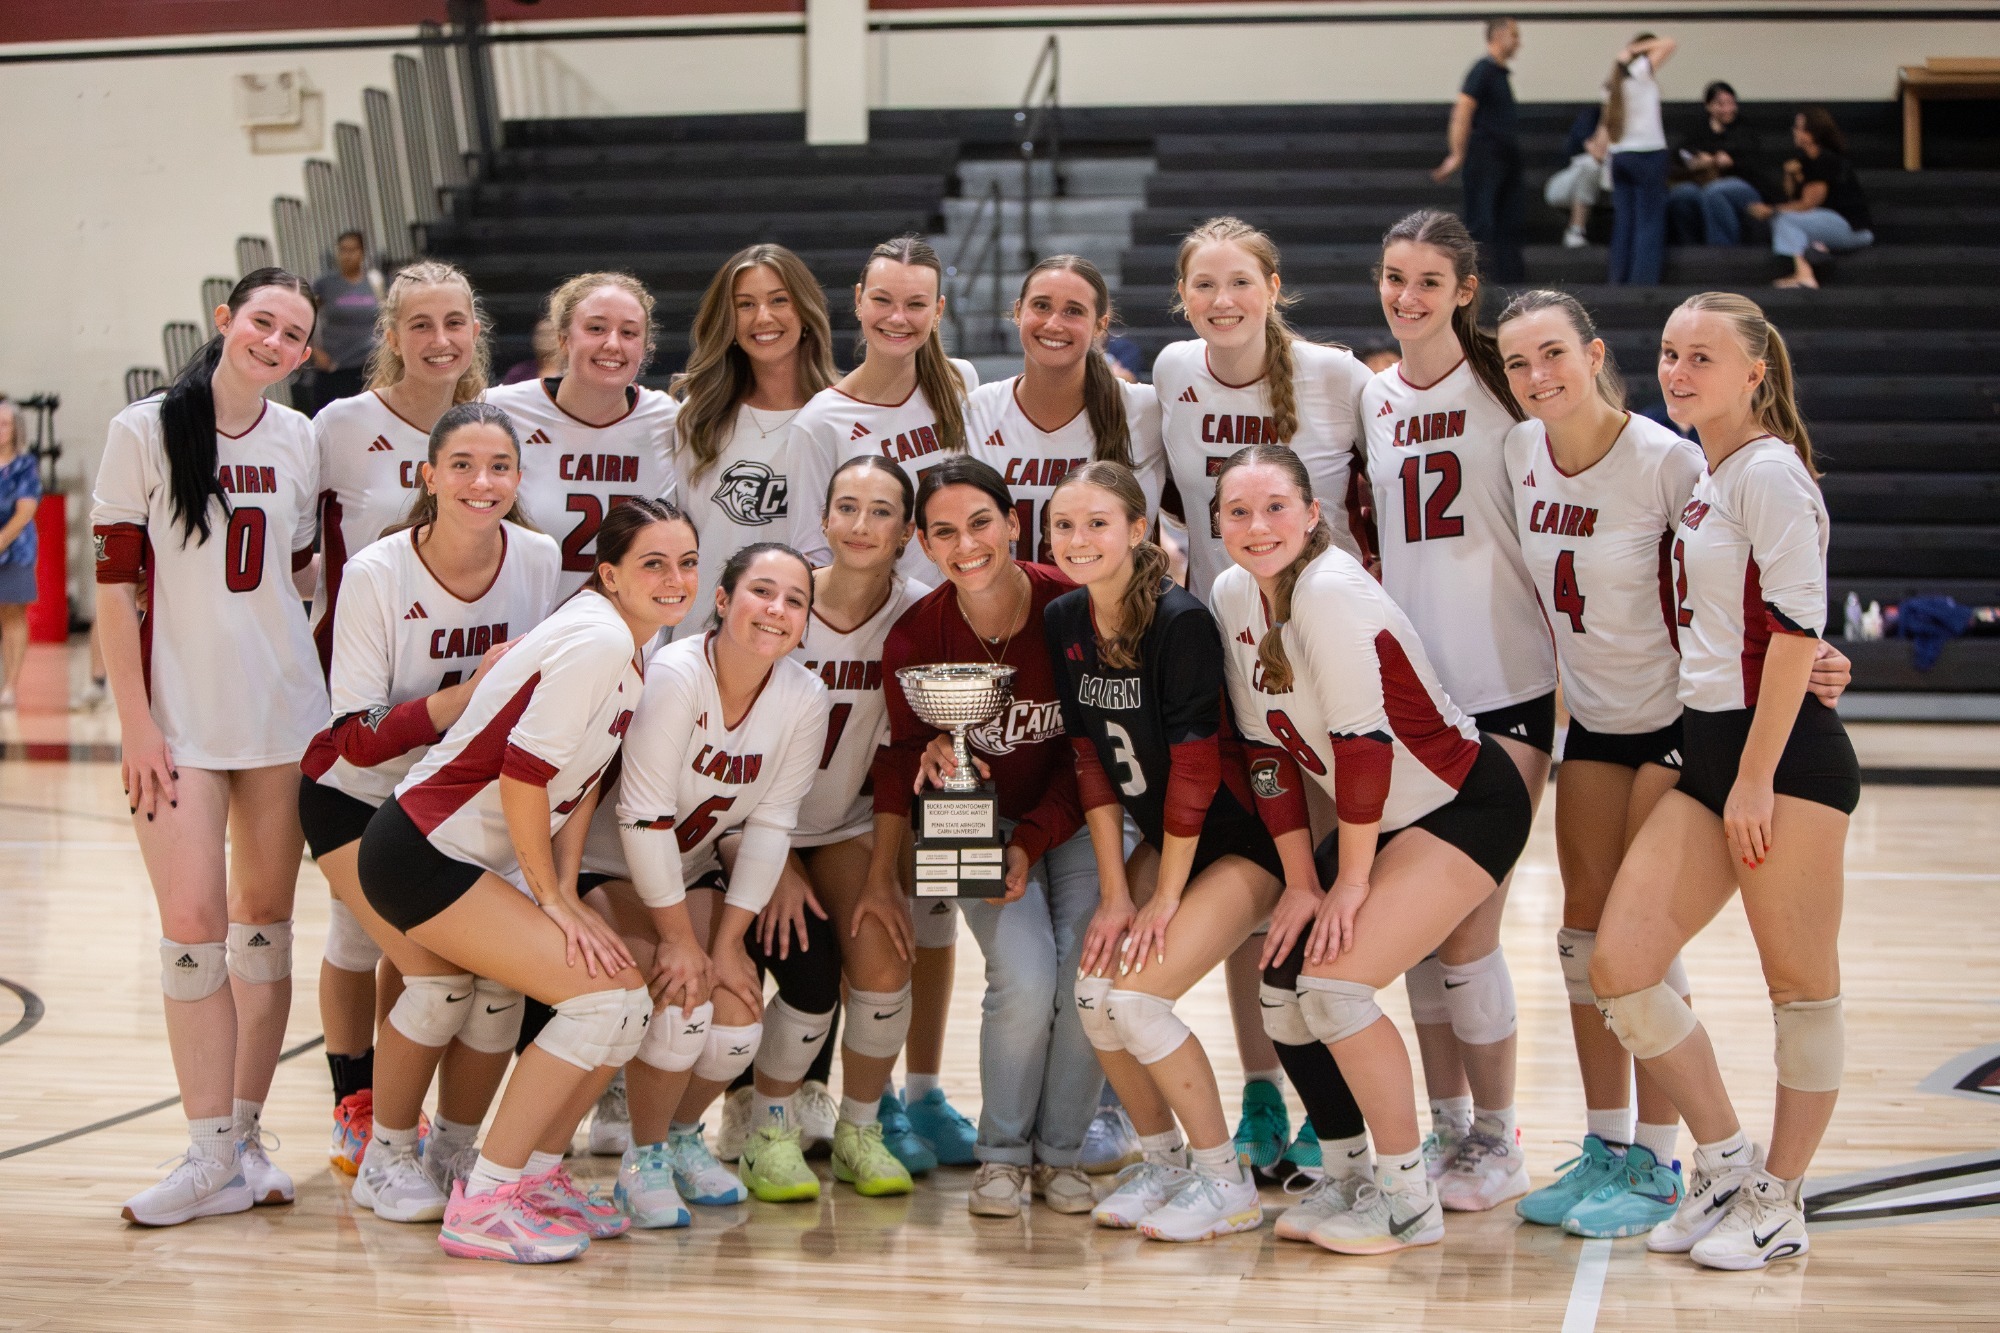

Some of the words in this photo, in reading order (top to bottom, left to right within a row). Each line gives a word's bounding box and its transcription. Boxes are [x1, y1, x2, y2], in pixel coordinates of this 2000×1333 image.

[1201, 413, 1280, 445] CAIRN
[1393, 409, 1467, 447] CAIRN
[218, 464, 277, 494] AIRN
[559, 453, 640, 483] CAIRN
[1398, 450, 1465, 544] 12
[561, 492, 642, 573] 2
[1529, 500, 1599, 538] CAIRN
[225, 506, 266, 593] 0
[1553, 549, 1587, 634] 4
[1078, 673, 1141, 709] CAIRN
[1105, 719, 1147, 797] 3
[1266, 708, 1328, 777] 8
[674, 794, 737, 854] 6
